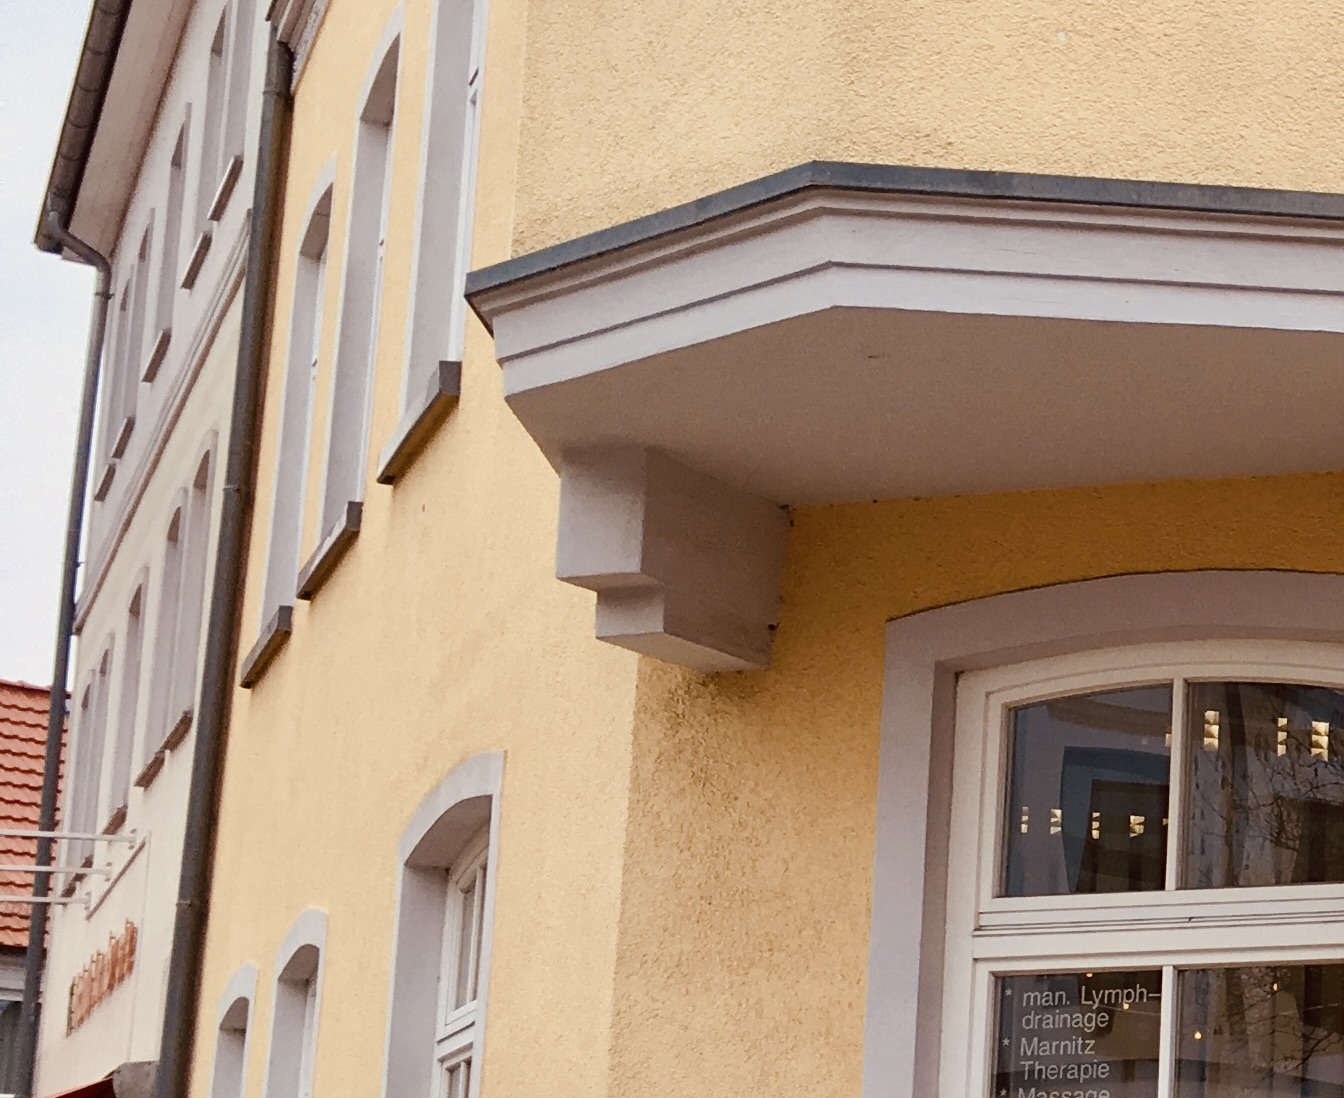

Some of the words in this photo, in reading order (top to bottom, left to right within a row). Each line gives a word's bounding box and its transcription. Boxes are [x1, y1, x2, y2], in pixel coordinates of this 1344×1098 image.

[1022, 990, 1071, 1007] man.
[1080, 983, 1162, 1010] Lymph-
[1021, 1009, 1110, 1032] drainage
[1019, 1035, 1096, 1057] Marnitz
[1019, 1059, 1110, 1083] Therapie
